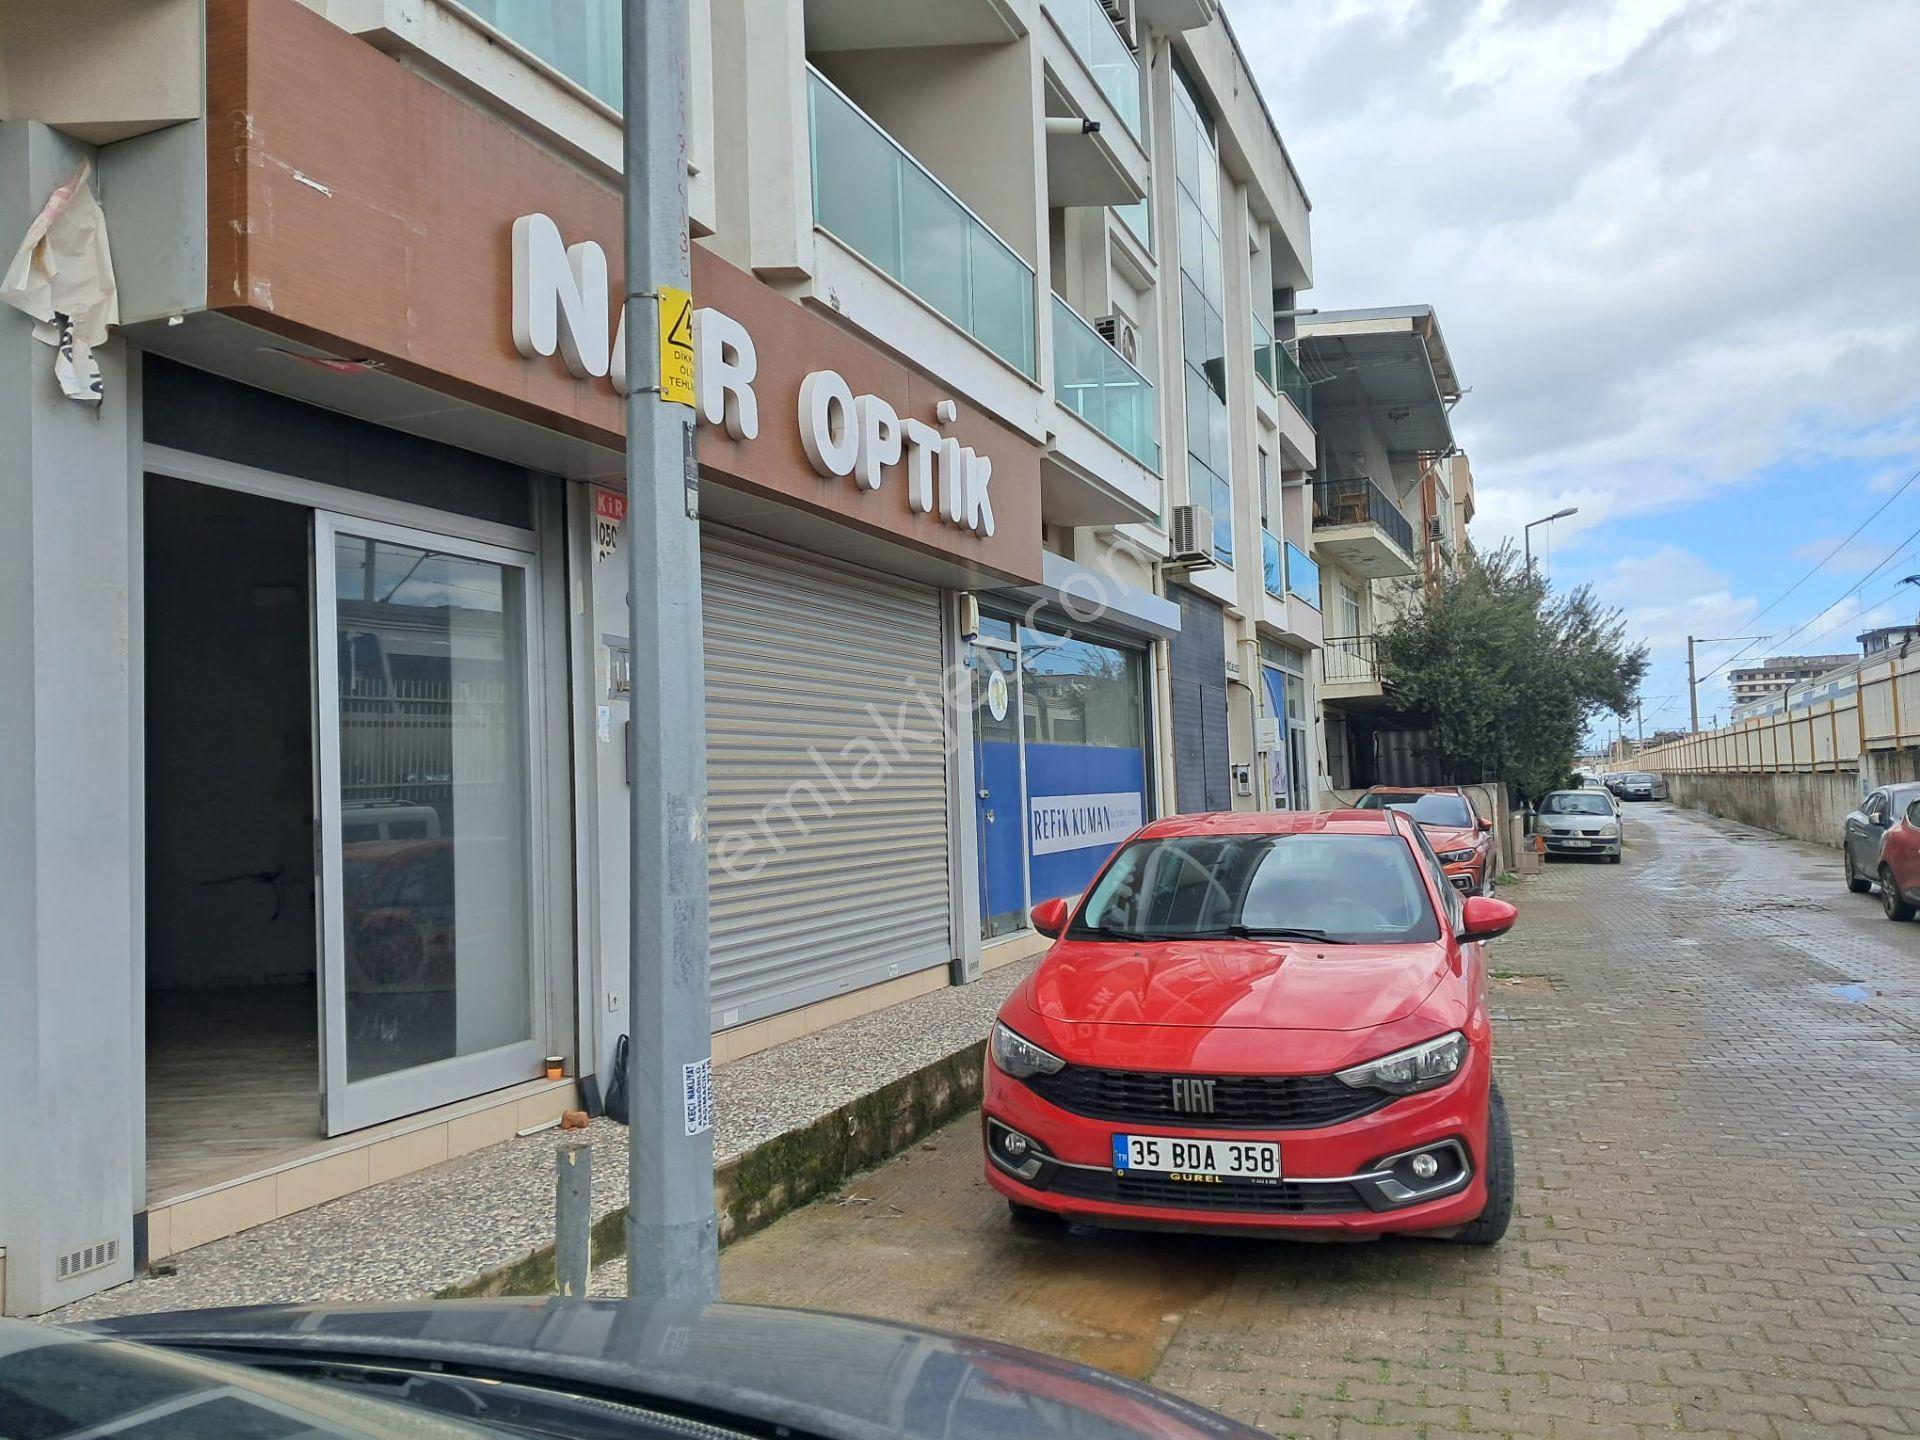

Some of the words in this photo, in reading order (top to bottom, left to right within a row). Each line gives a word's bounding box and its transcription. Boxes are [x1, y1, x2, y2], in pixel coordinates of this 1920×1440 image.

[512, 212, 759, 441] NR
[798, 369, 995, 539] OPTİK
[597, 494, 624, 516] KİR
[1172, 1079, 1216, 1113] FIAT
[1131, 1140, 1160, 1167] 35
[1172, 1143, 1216, 1171] BDA
[1228, 1146, 1274, 1174] 358
